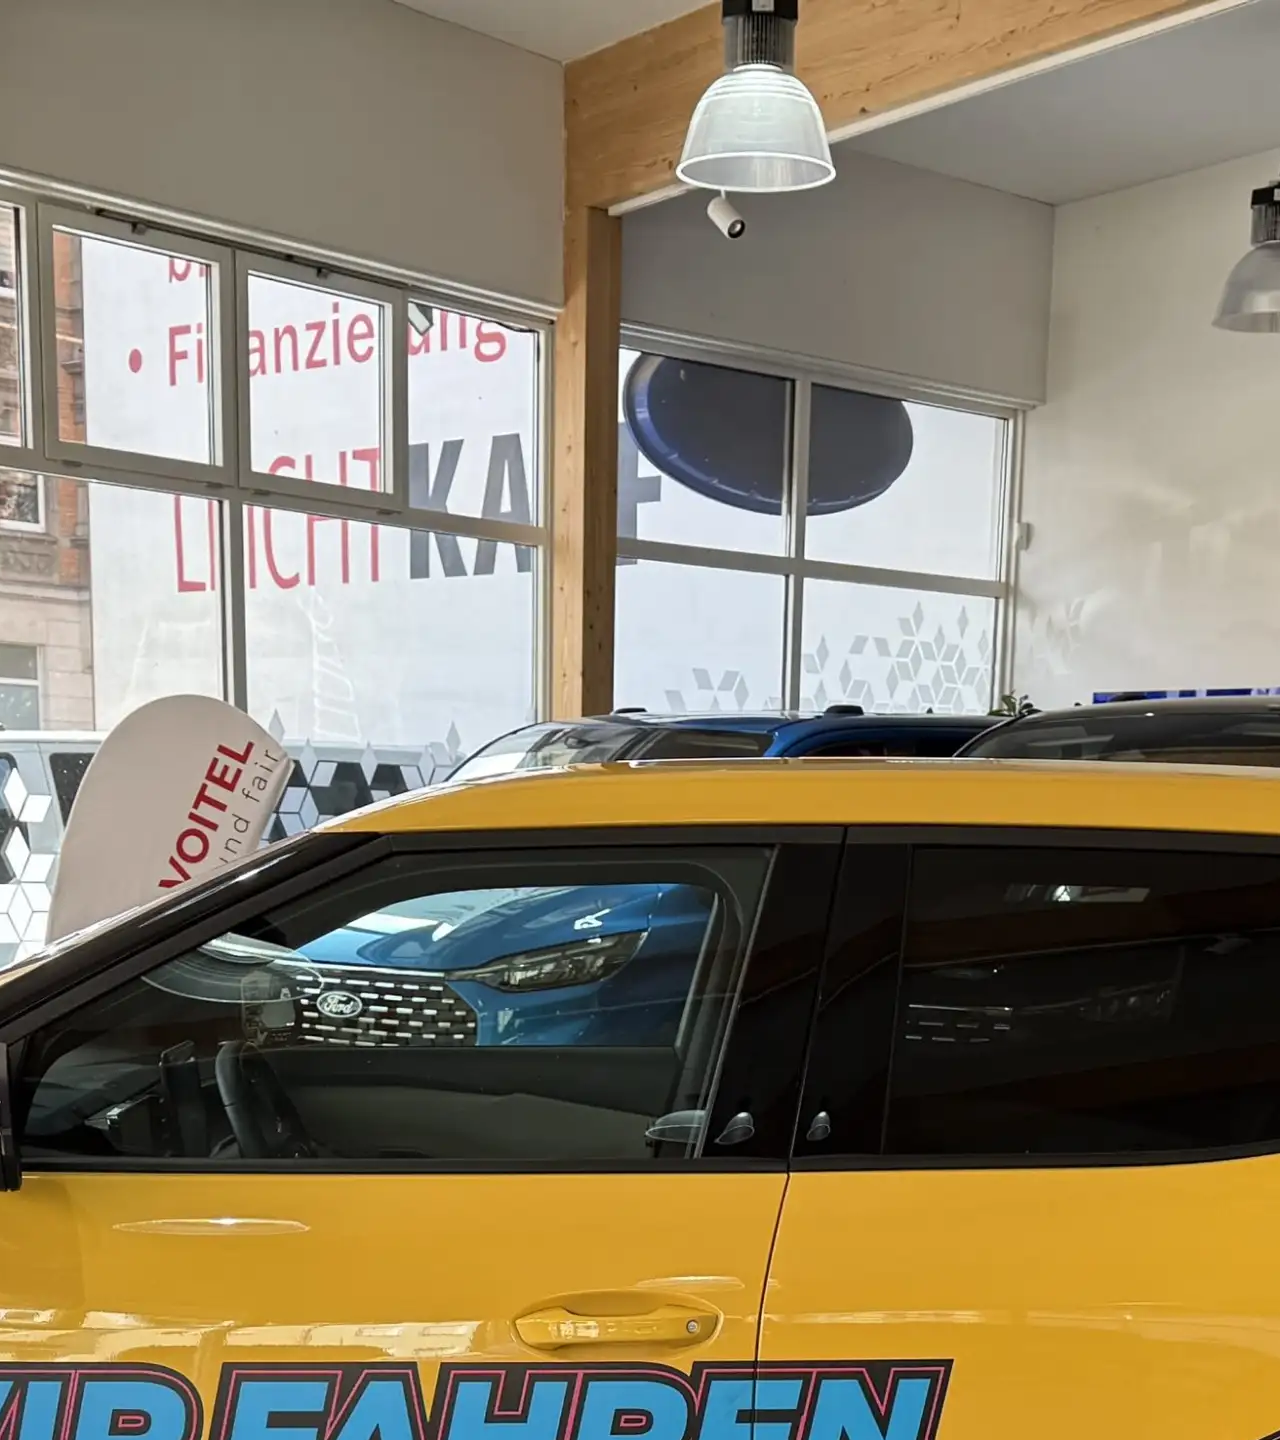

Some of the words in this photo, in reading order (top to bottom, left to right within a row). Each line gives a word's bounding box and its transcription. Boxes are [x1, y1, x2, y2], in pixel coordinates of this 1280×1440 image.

[168, 301, 508, 387] Fianzieung
[241, 749, 279, 803] fair
[158, 741, 255, 888] VOITEL
[324, 995, 354, 1014] Ford
